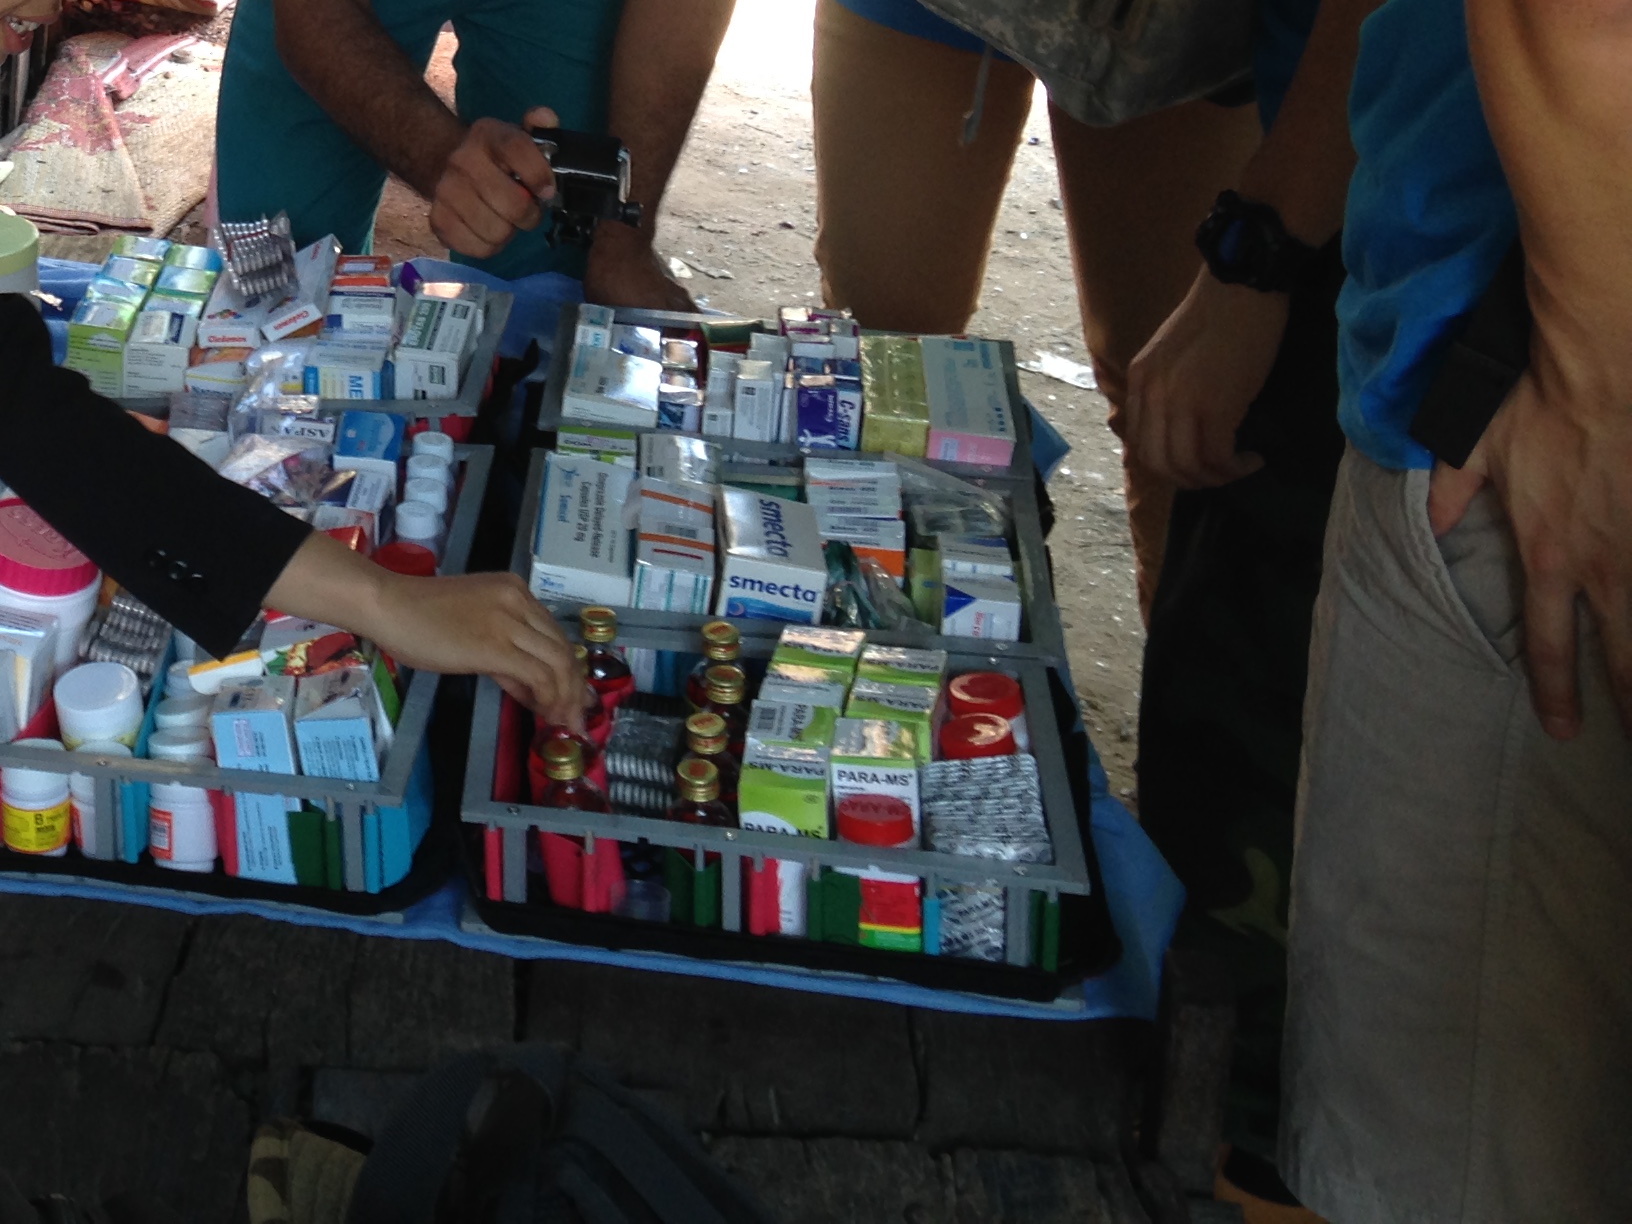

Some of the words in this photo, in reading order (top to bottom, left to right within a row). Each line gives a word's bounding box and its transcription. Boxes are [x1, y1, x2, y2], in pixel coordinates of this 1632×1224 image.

[759, 498, 794, 559] smecta
[728, 574, 819, 604] smecta
[837, 769, 911, 787] PARA-MS
